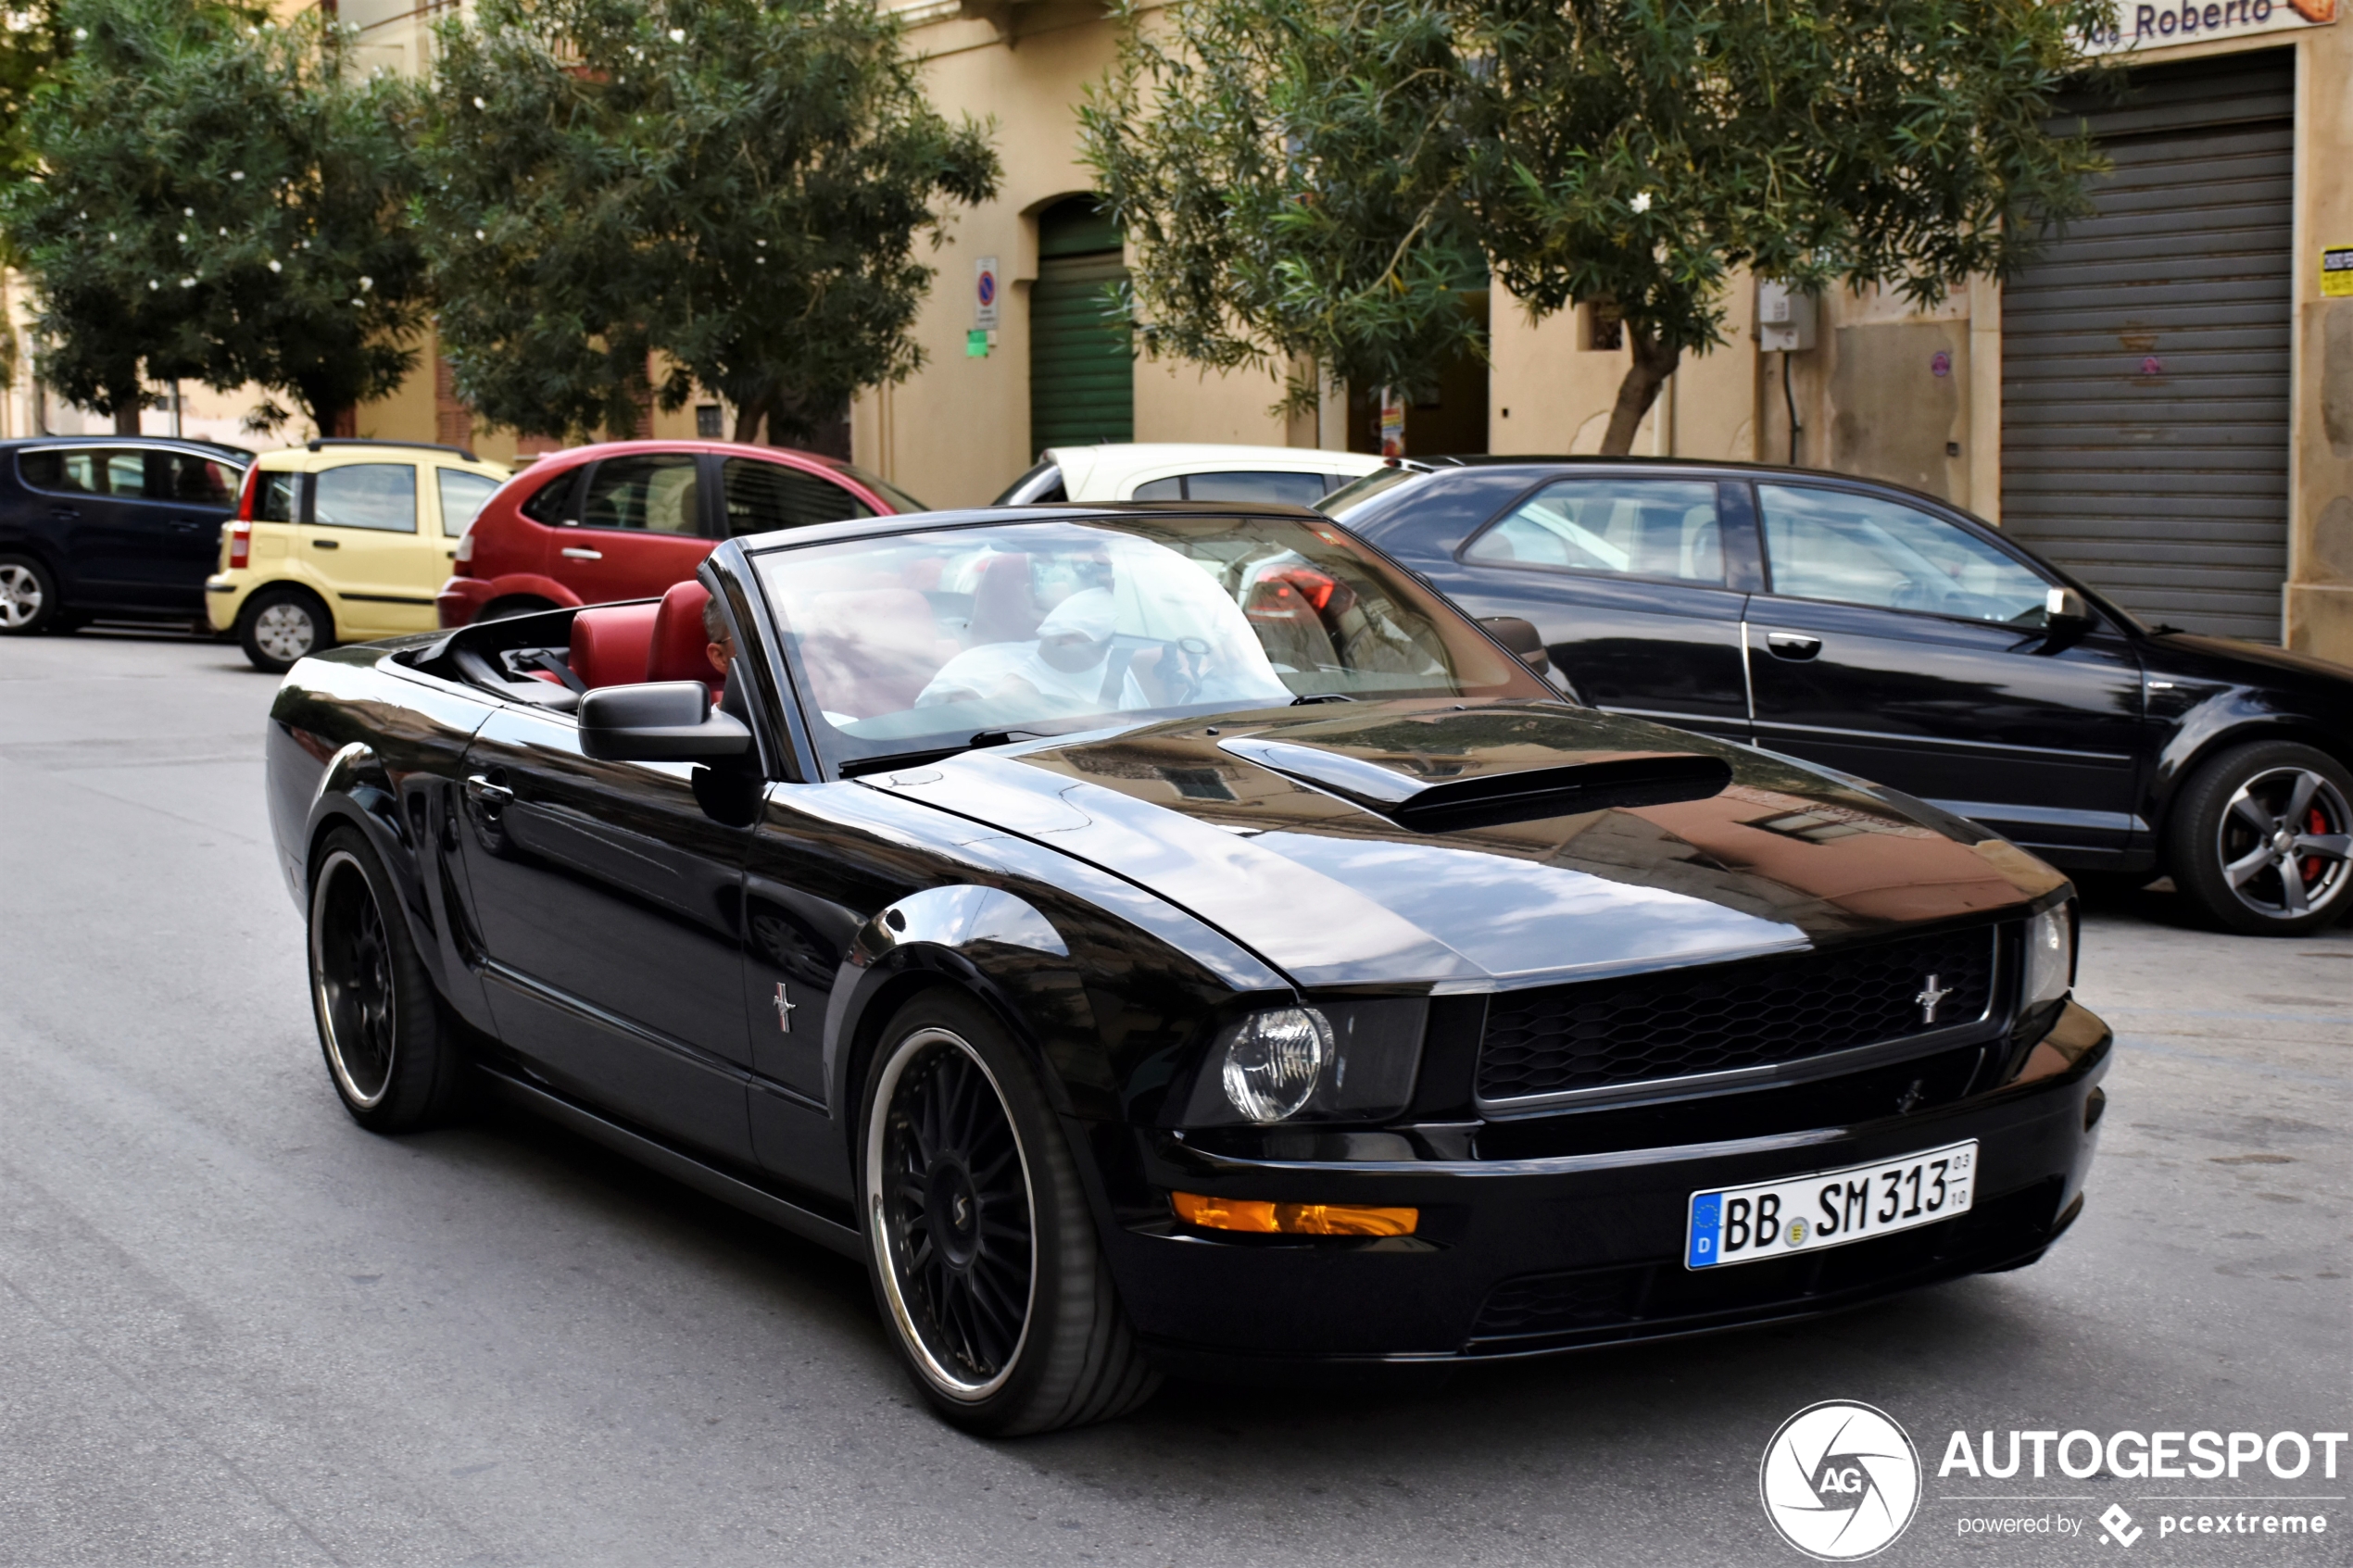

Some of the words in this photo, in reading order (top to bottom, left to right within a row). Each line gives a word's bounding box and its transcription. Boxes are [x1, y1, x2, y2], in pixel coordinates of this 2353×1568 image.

[2135, 0, 2272, 37] Roberto
[1953, 1154, 1969, 1170] 03
[1725, 1193, 1780, 1251] BB
[1817, 1177, 1869, 1237] SM
[1879, 1159, 1948, 1224] 313
[1951, 1190, 1967, 1206] 10
[1698, 1237, 1710, 1253] D
